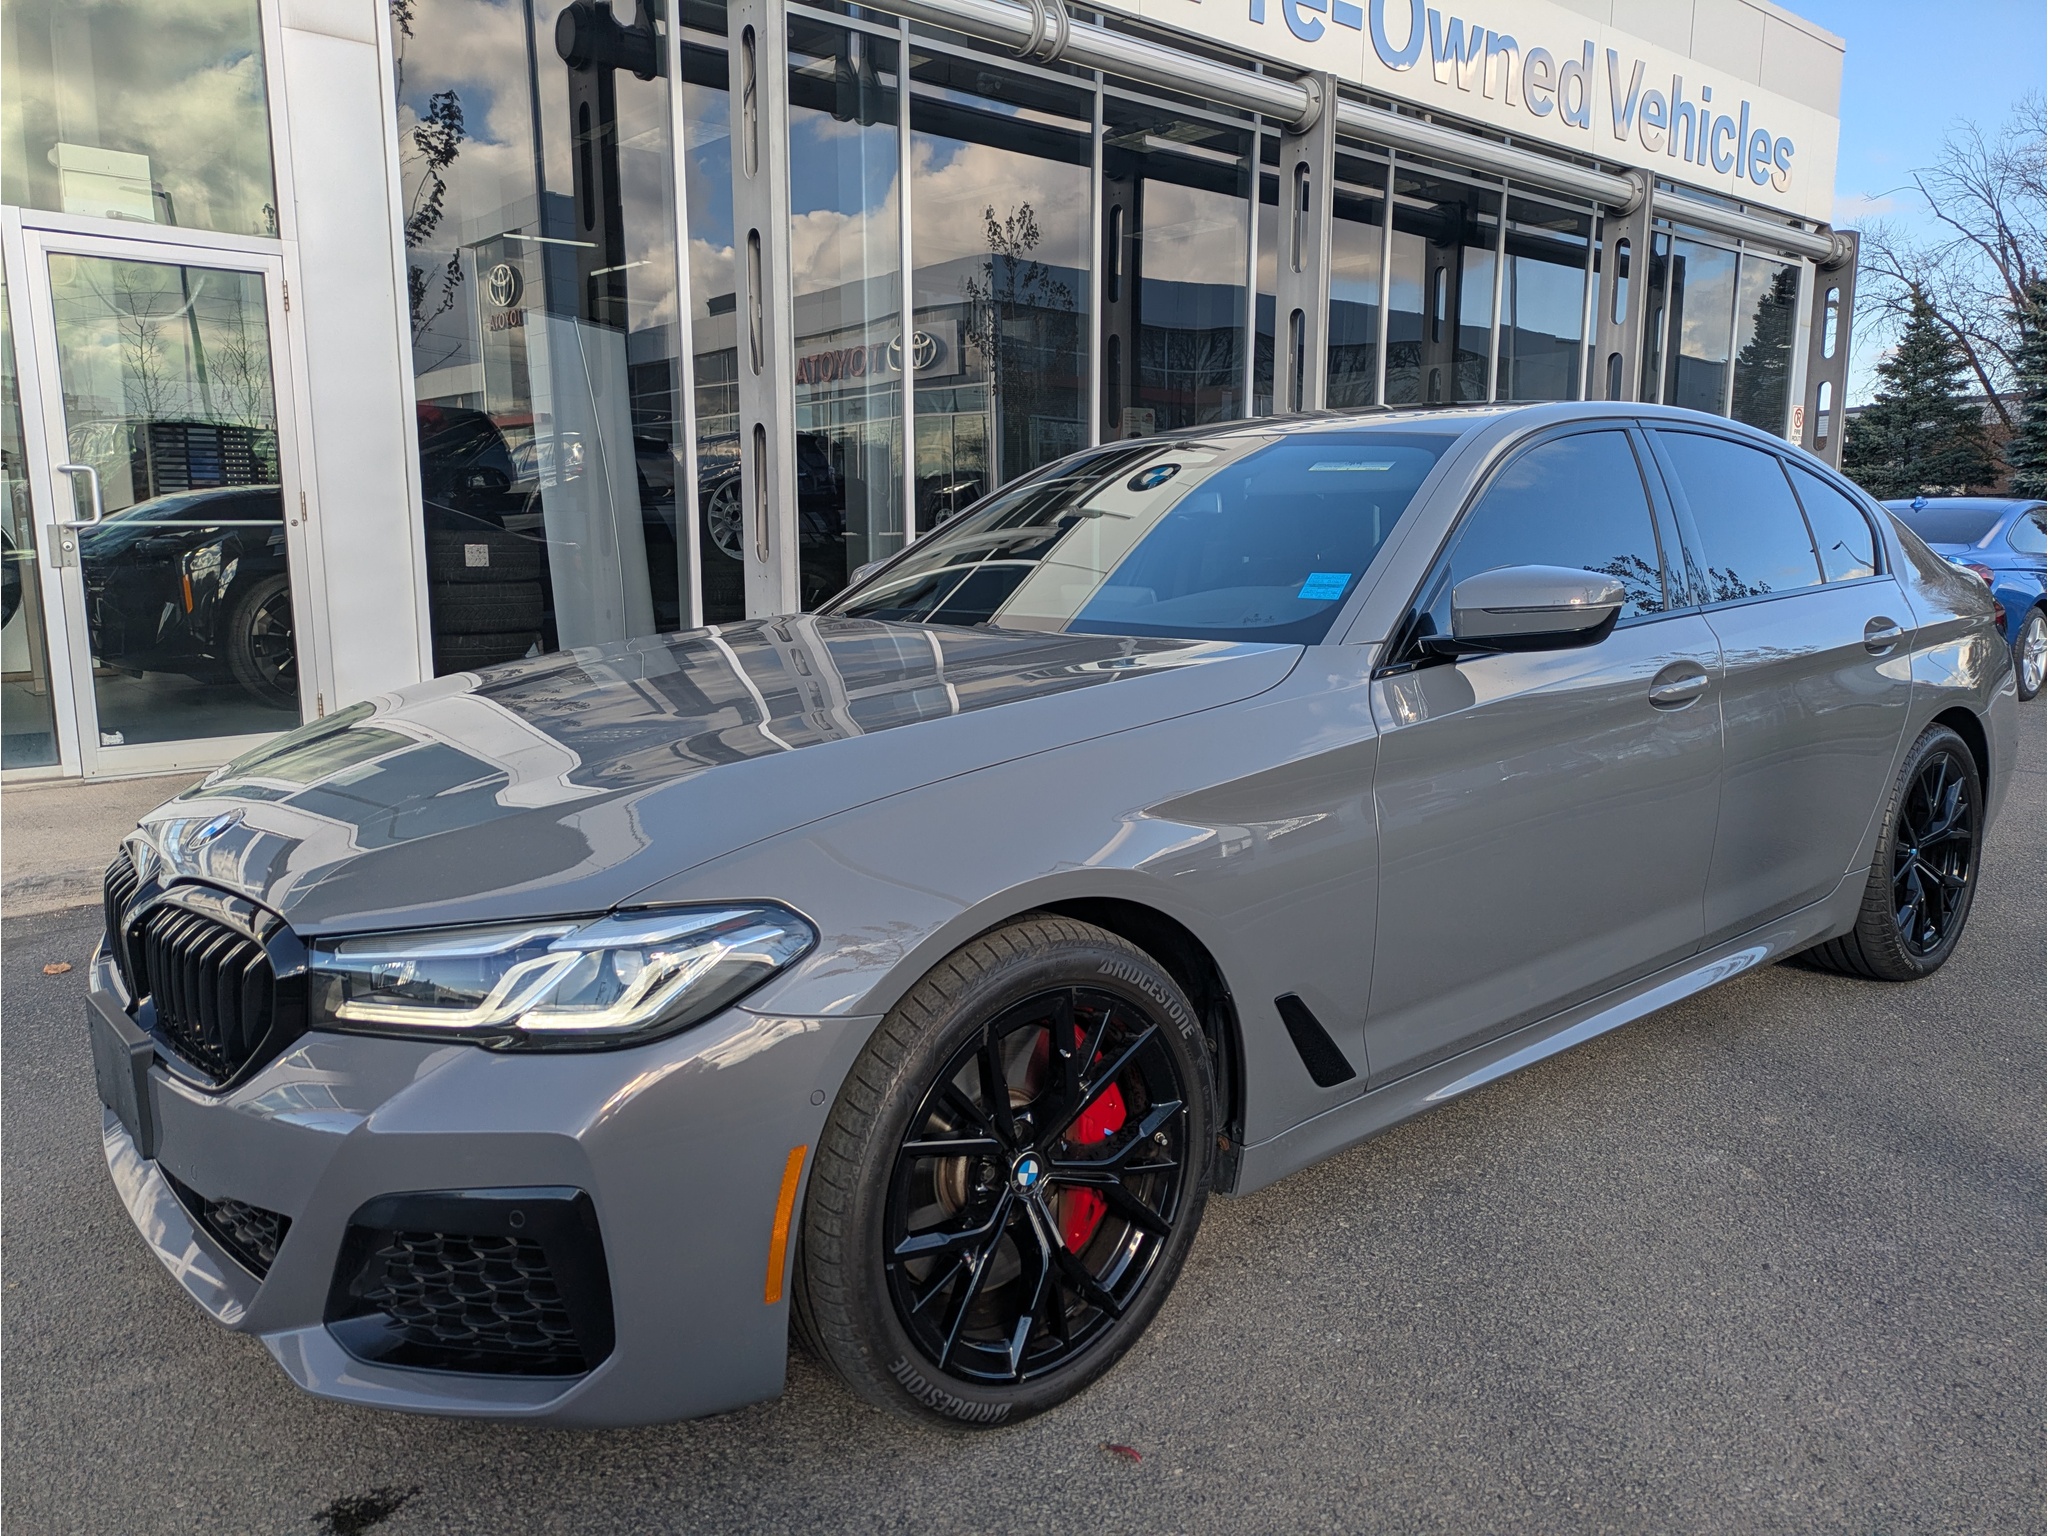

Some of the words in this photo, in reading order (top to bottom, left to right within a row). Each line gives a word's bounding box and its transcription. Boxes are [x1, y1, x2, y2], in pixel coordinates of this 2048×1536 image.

[1187, 0, 1595, 130] e-Owned
[1606, 48, 1795, 193] Vehicles
[1097, 959, 1195, 1040] BRIDGESTONE
[888, 1355, 1013, 1423] BRIDGESTONE
